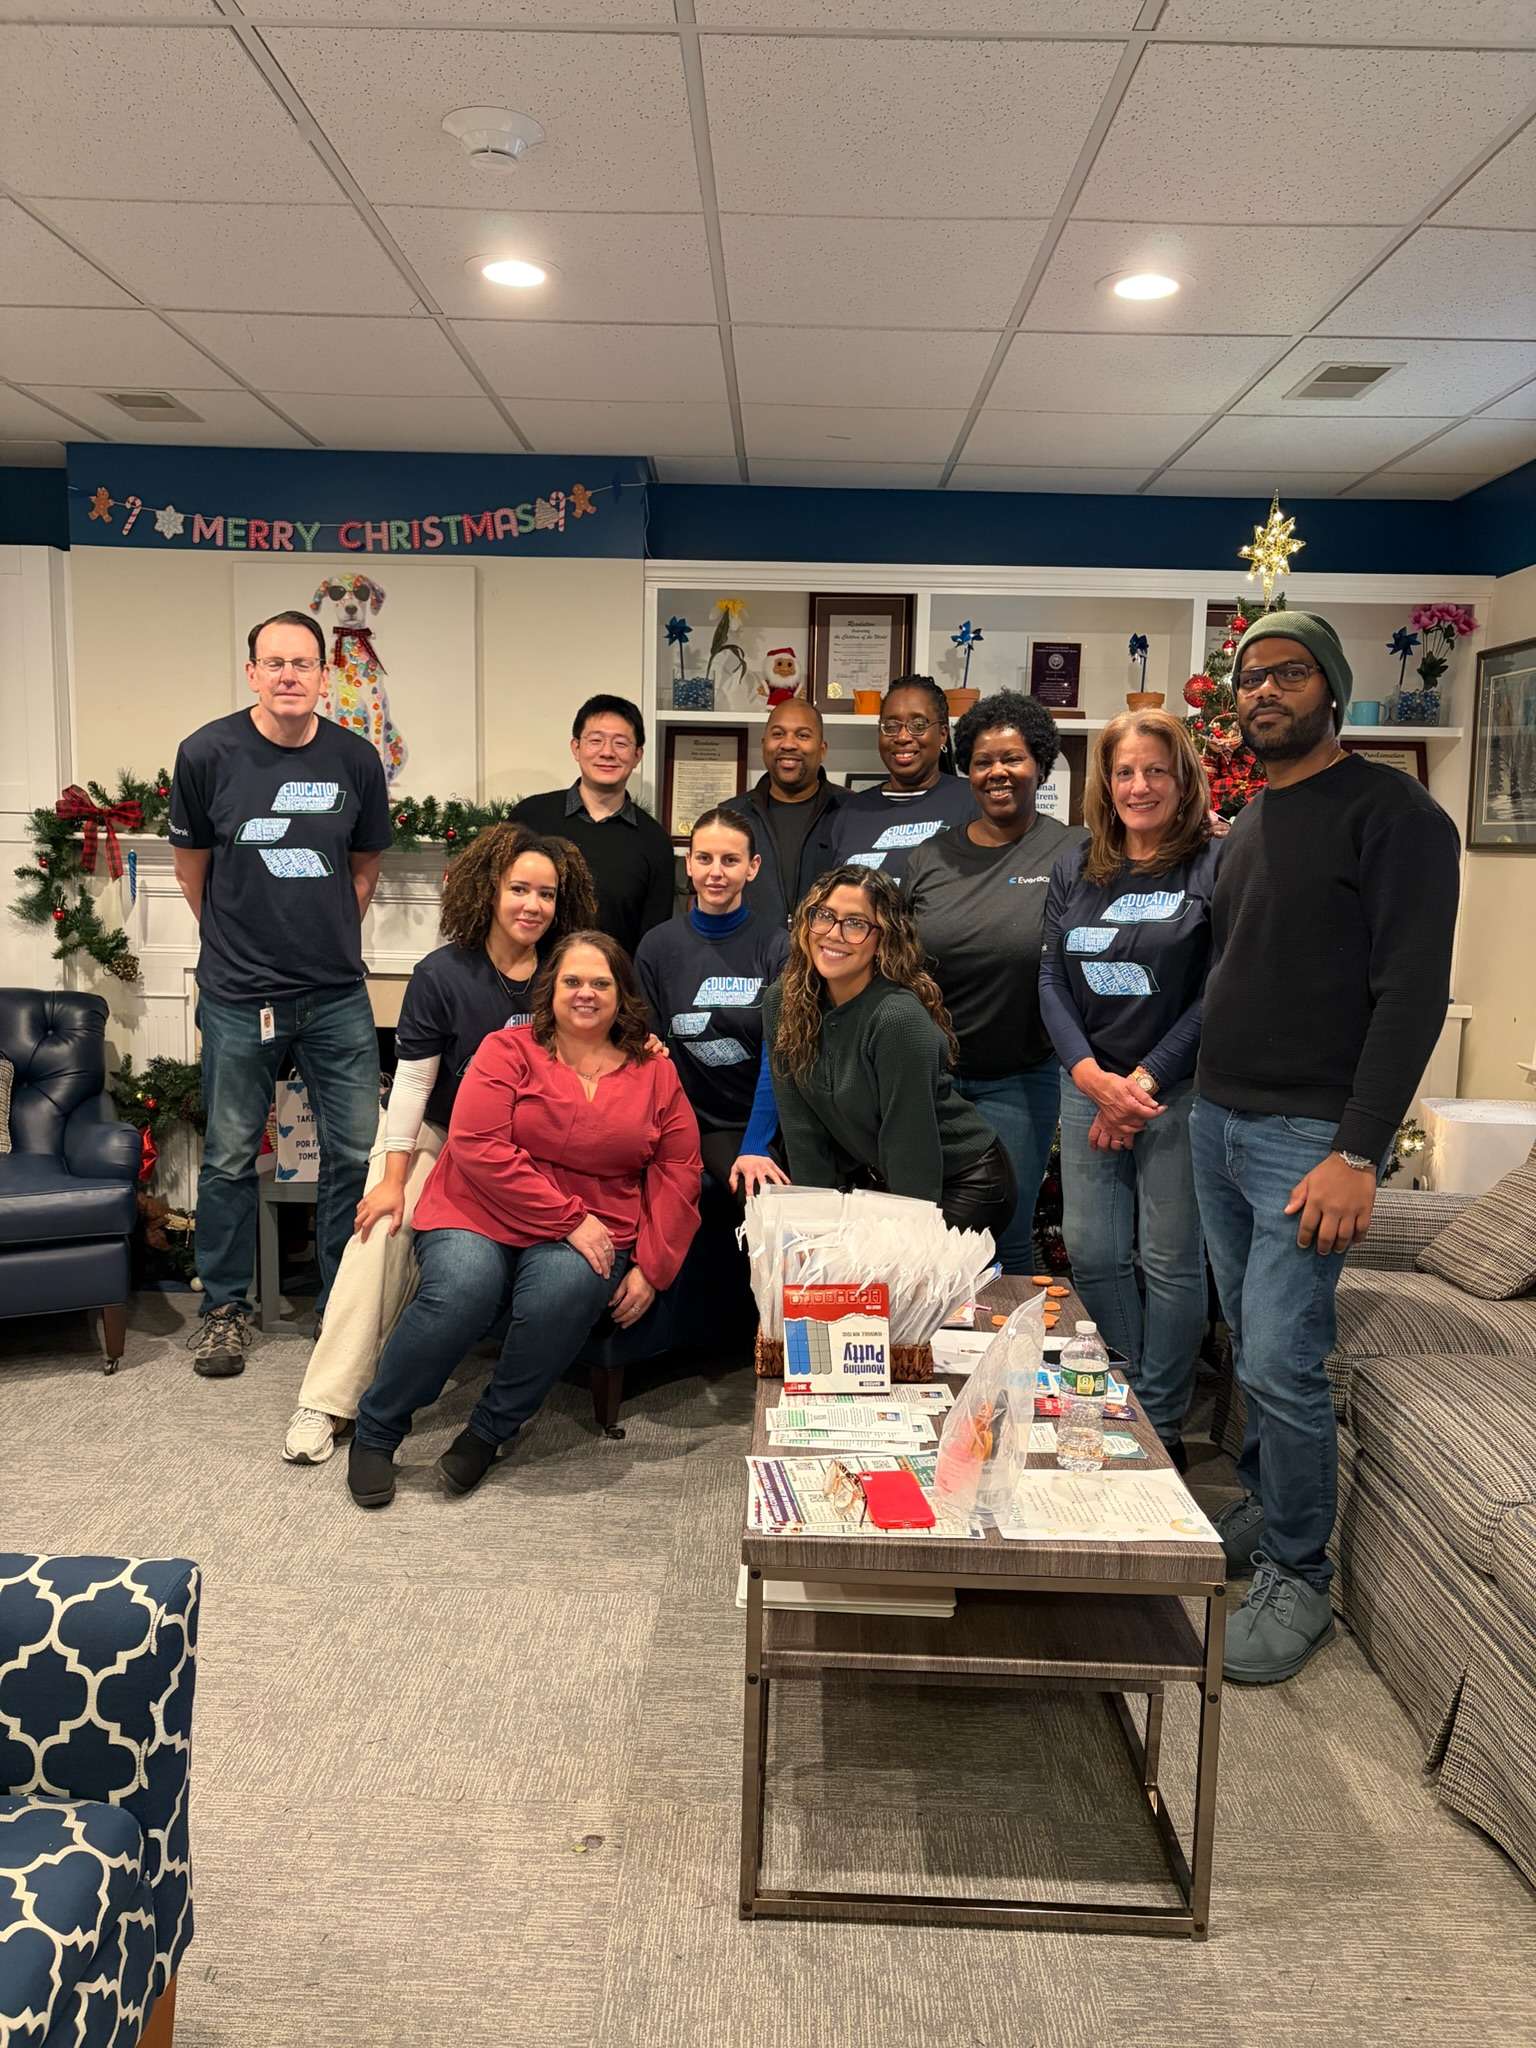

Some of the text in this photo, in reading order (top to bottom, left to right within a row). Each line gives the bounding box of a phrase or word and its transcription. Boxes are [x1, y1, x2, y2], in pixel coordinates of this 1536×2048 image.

[192, 503, 536, 551] MERRY CHRISTMAS
[283, 782, 338, 797] EDUCATION
[887, 820, 942, 835] EDUCATION
[706, 977, 762, 992] EDUCATION
[296, 1140, 311, 1148] POR
[298, 1152, 318, 1160] TOME
[843, 1342, 885, 1363] Putty
[843, 1364, 885, 1375] Mounting
